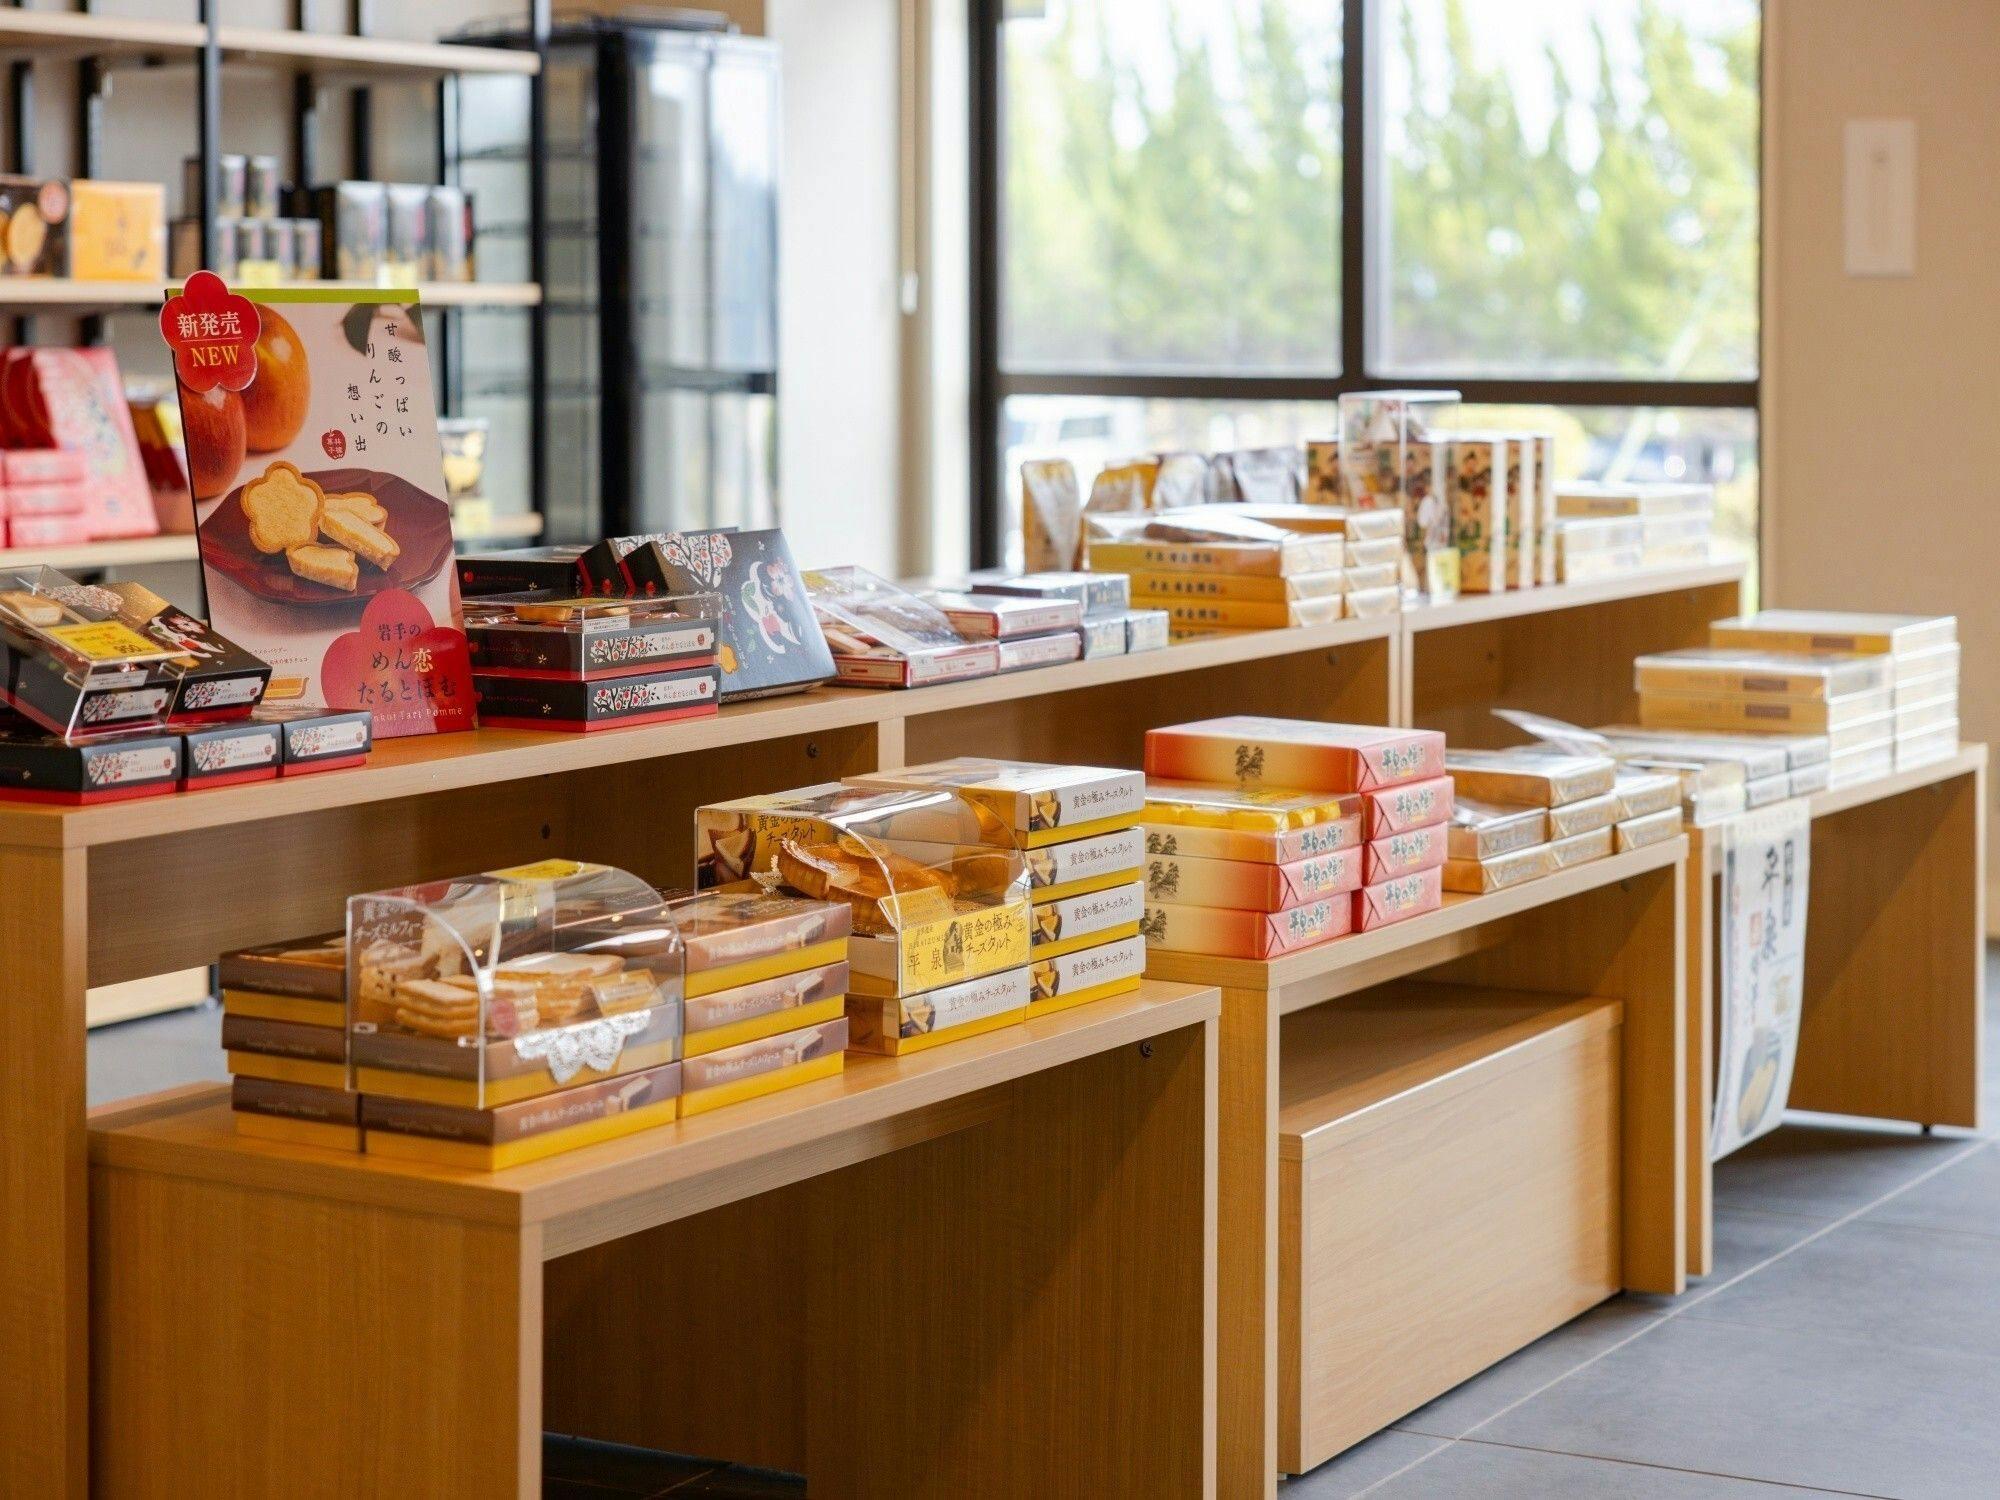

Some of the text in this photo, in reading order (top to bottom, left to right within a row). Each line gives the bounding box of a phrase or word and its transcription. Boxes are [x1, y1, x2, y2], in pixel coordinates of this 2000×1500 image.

[177, 311, 241, 338] 新発売
[191, 345, 239, 367] NEW
[367, 343, 388, 434] りんごの
[385, 323, 412, 436] 甘酸っぱい
[347, 383, 366, 452] 想い出
[377, 623, 421, 642] 岩手の
[372, 648, 434, 672] めん恋
[426, 707, 463, 718] Pomme
[963, 913, 1013, 942] 黄金の極み
[908, 949, 943, 975] 平泉
